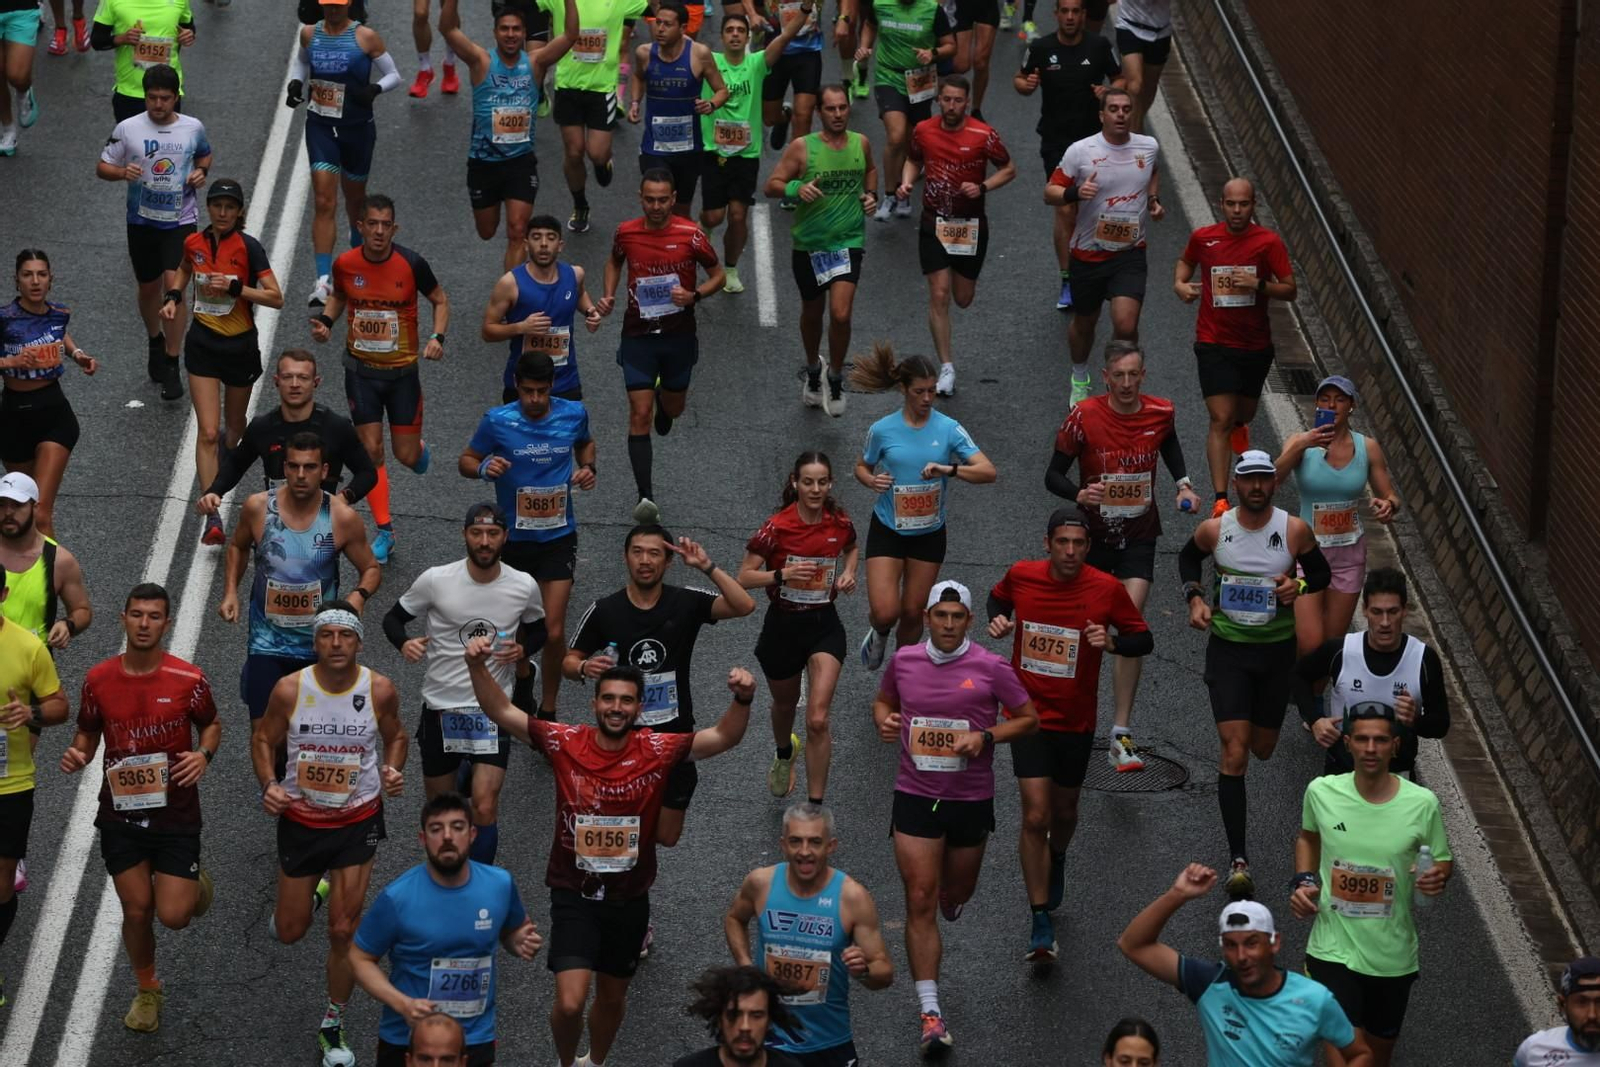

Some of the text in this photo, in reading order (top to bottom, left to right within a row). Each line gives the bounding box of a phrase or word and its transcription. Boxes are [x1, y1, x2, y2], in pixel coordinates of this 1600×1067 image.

[140, 44, 165, 56] 6152
[498, 115, 524, 127] 4202
[658, 125, 682, 137] 3052
[159, 142, 183, 151] HUELVA
[145, 191, 173, 205] 2302
[942, 226, 968, 239] 5888
[1102, 223, 1131, 237] 5795
[359, 321, 387, 334] 5007
[531, 337, 559, 350] 6143
[1109, 484, 1141, 499] 6345
[524, 496, 556, 511] 3681
[902, 494, 933, 509] 3993
[272, 595, 309, 608] 4906
[1229, 587, 1263, 604] 2445
[1029, 636, 1064, 655] 4375
[449, 715, 484, 731] 3236
[917, 731, 954, 748] 4389
[298, 743, 366, 754] GRANADA
[118, 768, 156, 787] 5363
[305, 765, 346, 784] 5575
[584, 830, 625, 847] 6156
[1339, 874, 1379, 894] 3998
[798, 921, 834, 937] ULSA
[440, 973, 479, 991] 2766
